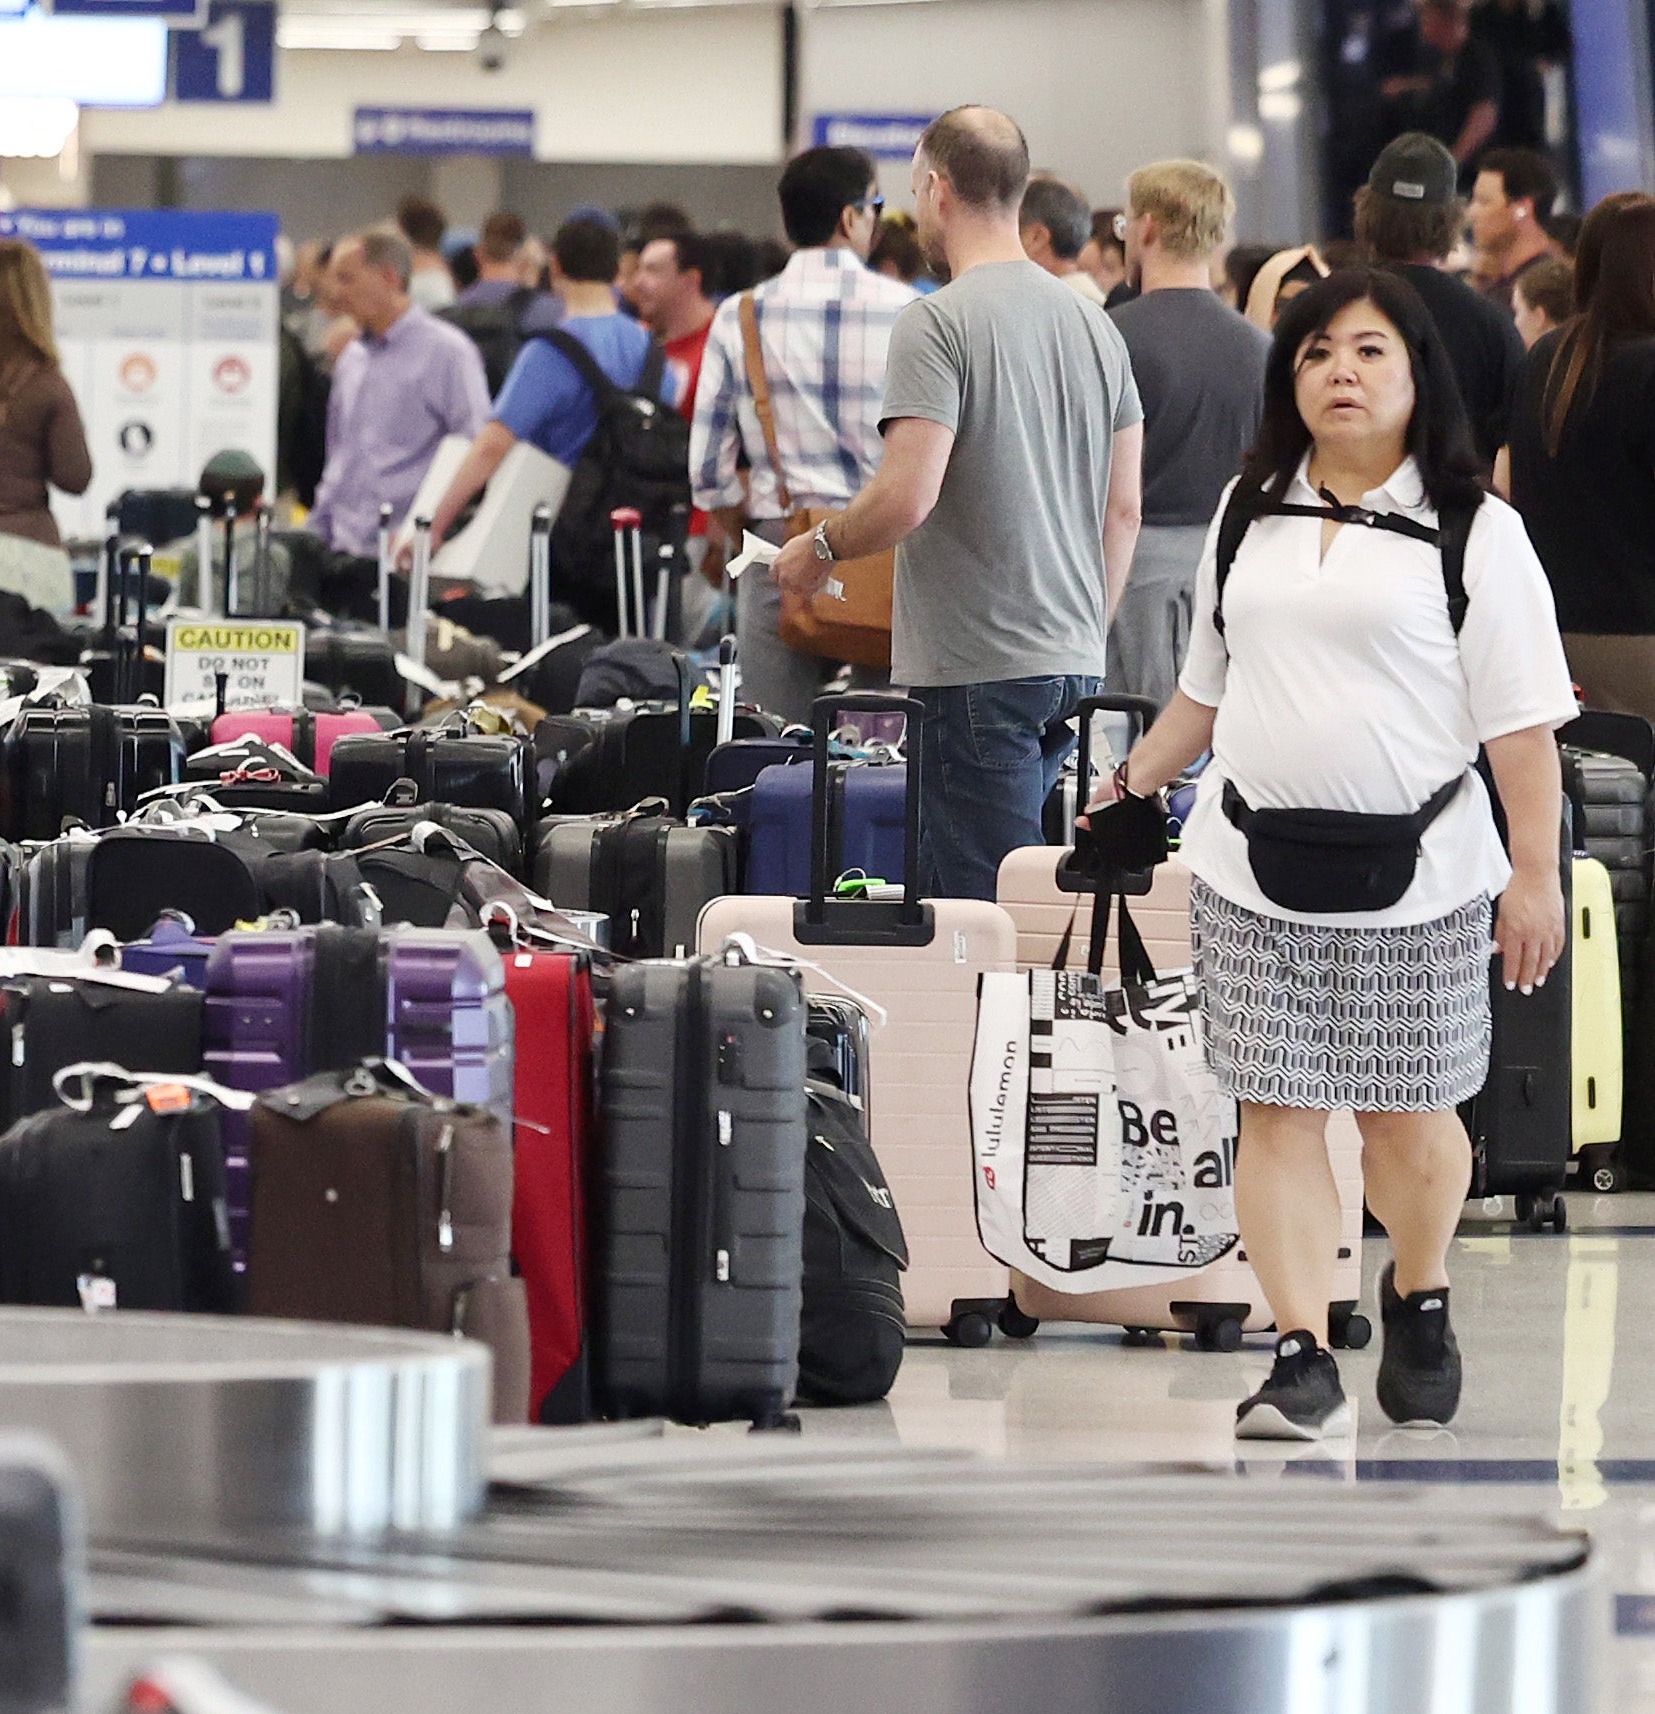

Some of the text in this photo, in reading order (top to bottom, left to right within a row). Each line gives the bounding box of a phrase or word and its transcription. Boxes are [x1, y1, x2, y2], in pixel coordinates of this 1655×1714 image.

[199, 12, 245, 96] 1
[179, 629, 291, 649] CAUTION
[198, 657, 269, 670] DO NOT
[238, 676, 265, 688] ON
[1118, 1100, 1180, 1148] Be
[1137, 1188, 1195, 1237] in.
